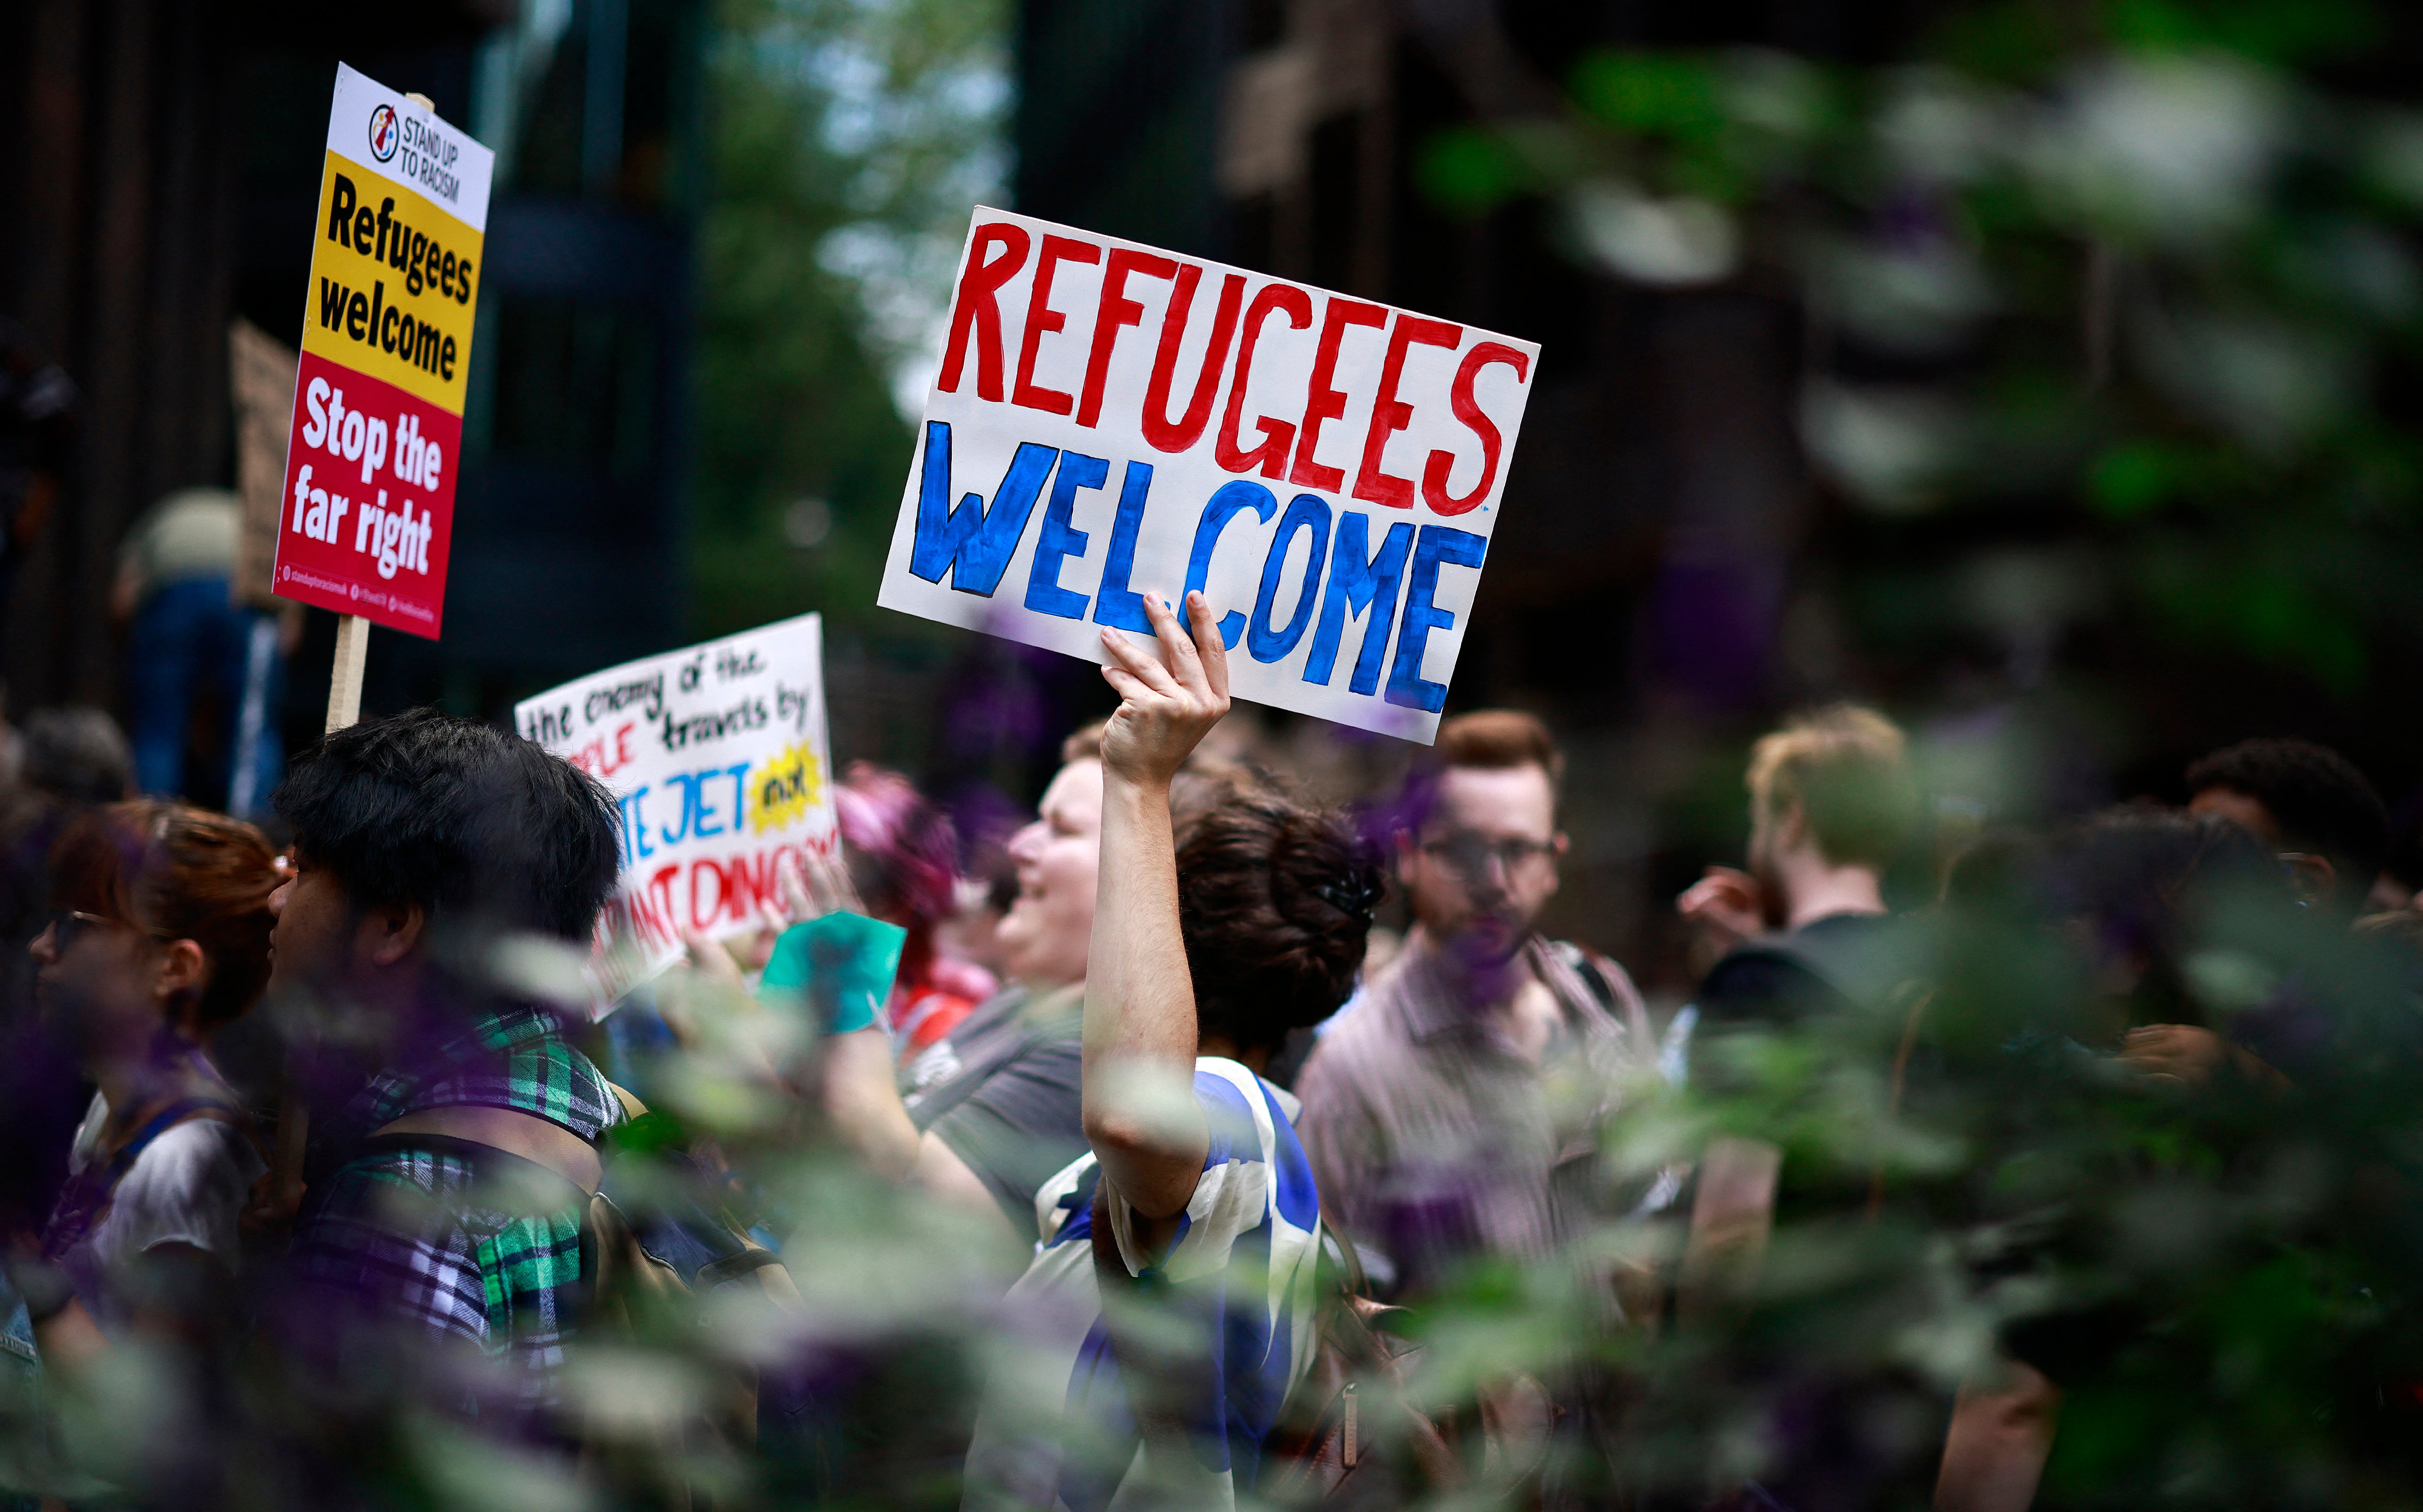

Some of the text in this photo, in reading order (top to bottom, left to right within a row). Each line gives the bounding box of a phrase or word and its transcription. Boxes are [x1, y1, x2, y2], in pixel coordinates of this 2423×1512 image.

[400, 145, 460, 204] TO RACISM
[403, 116, 458, 170] STAND UP
[328, 172, 472, 306] Refugees
[321, 276, 456, 382] welcome
[938, 223, 1529, 516] REFUGEES
[303, 377, 441, 492] Stop the
[292, 464, 432, 579] far right
[909, 421, 1487, 713] WELCOME
[527, 647, 766, 746] the enemy of the
[659, 698, 768, 752] travels
[776, 681, 808, 733] by
[661, 759, 753, 846] JET
